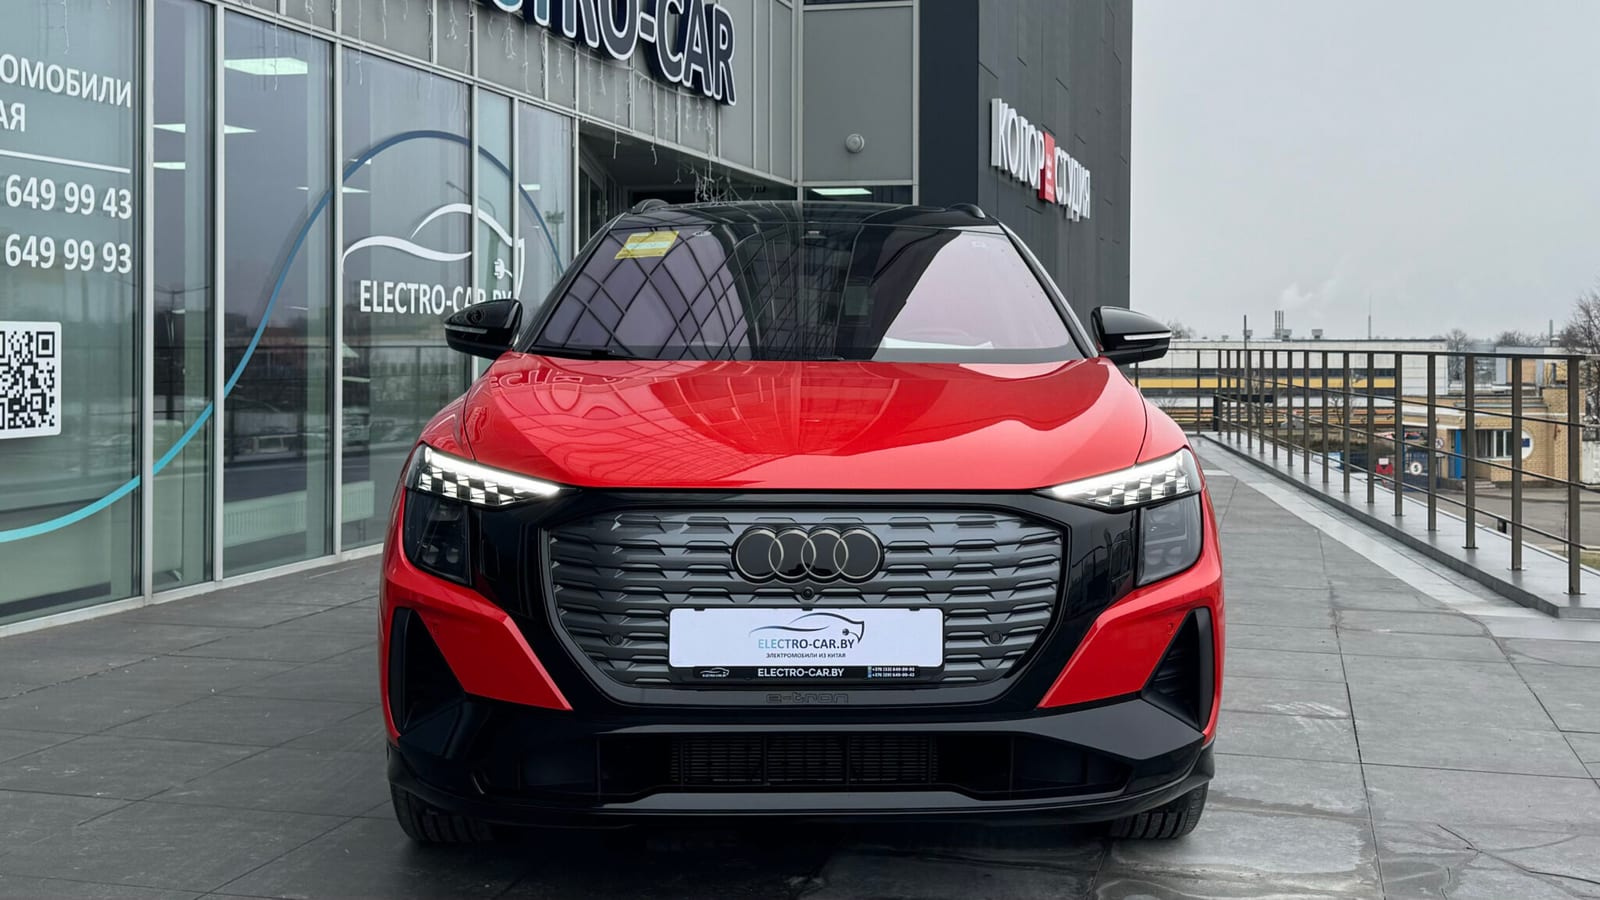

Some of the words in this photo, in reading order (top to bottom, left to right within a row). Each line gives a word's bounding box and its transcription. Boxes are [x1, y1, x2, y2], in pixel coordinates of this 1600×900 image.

[0, 54, 131, 108] ОМОБИЛИ
[5, 174, 56, 211] 649
[64, 182, 95, 215] 99
[102, 187, 132, 219] 43
[1054, 147, 1091, 222] СТУДИЯ
[5, 233, 55, 269] 649
[63, 239, 95, 271] 99
[102, 242, 132, 274] 93
[758, 638, 855, 649] ELECTRO-CAR.BY
[757, 668, 845, 677] ELECTRO-CAR.BY
[766, 692, 849, 704] e-tron
